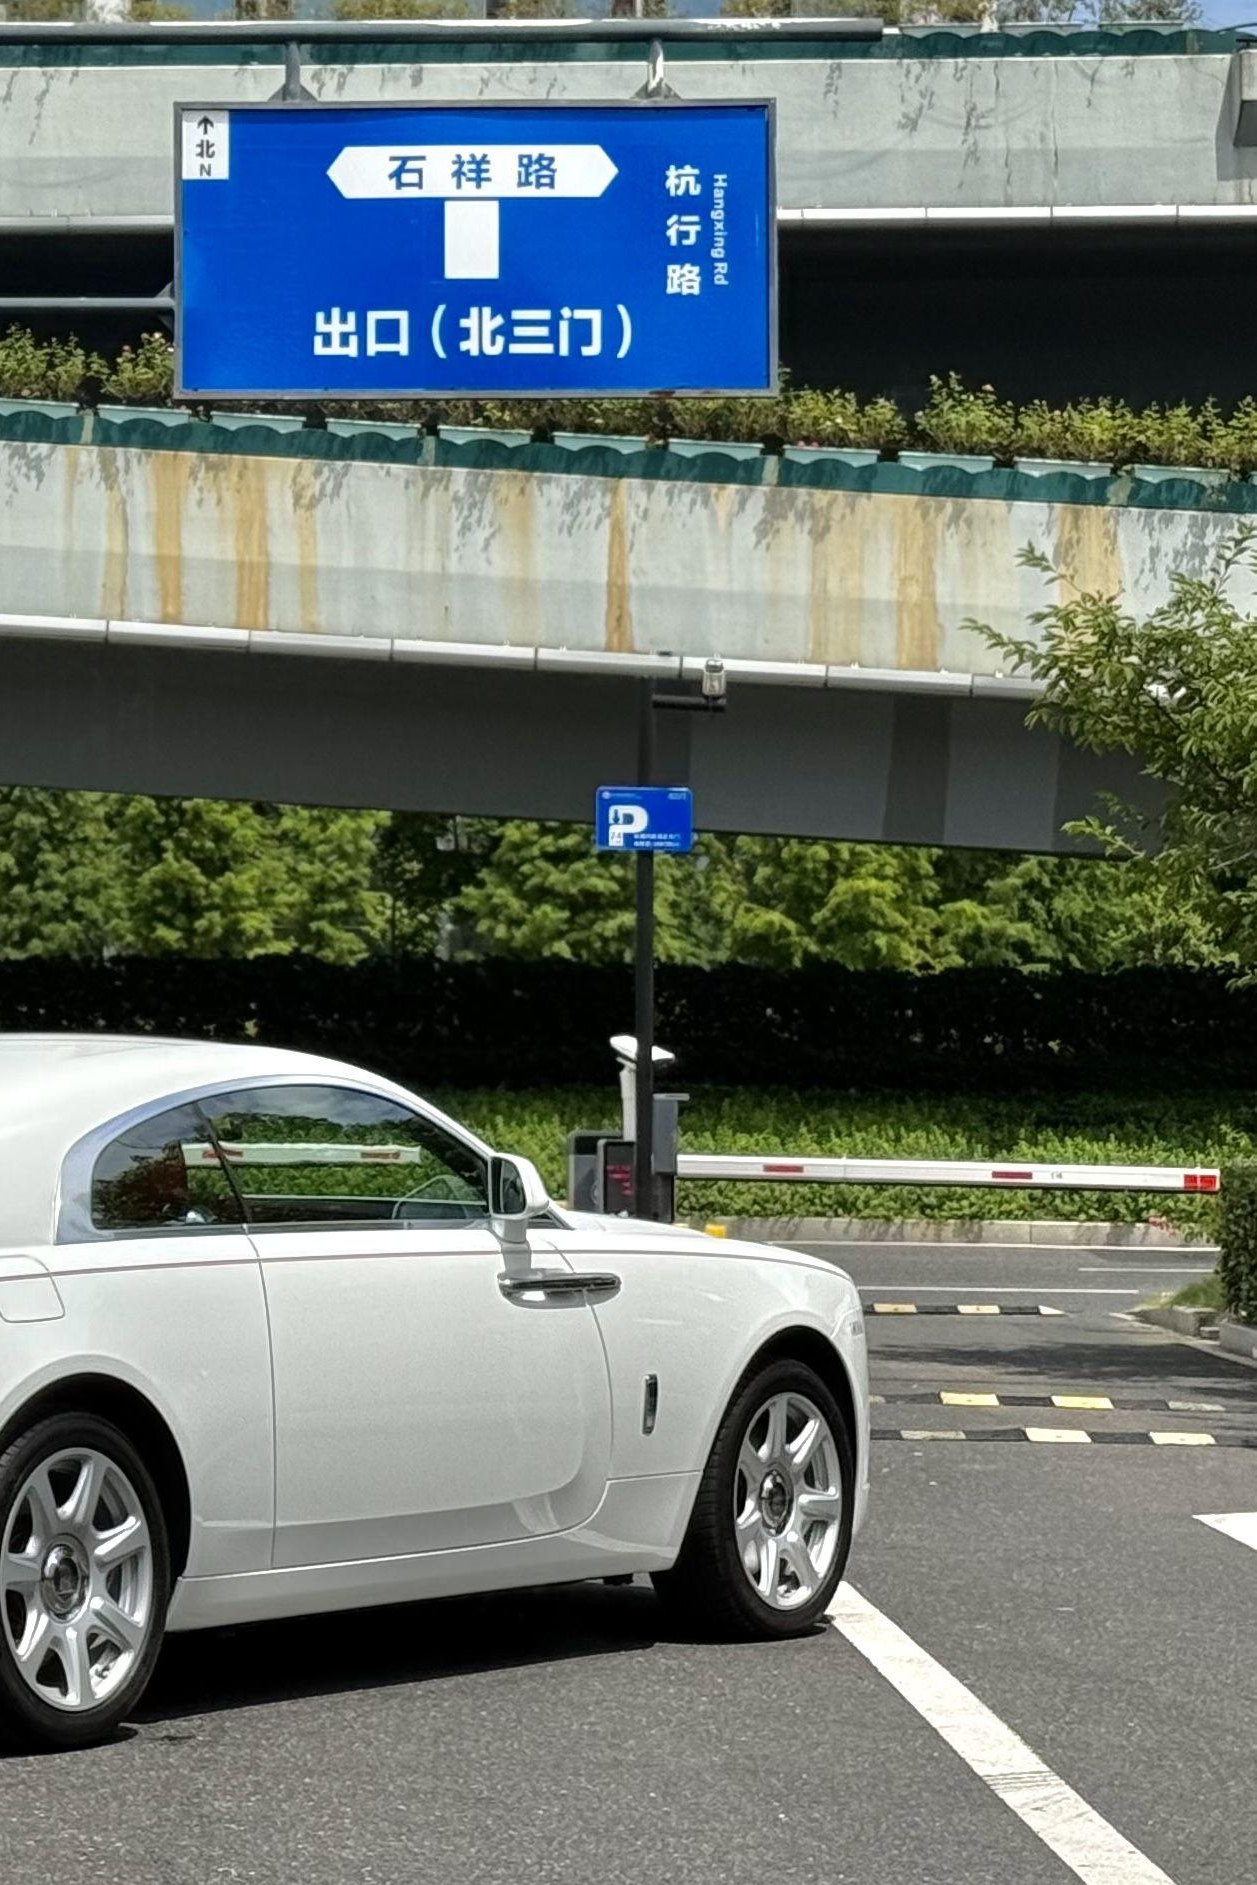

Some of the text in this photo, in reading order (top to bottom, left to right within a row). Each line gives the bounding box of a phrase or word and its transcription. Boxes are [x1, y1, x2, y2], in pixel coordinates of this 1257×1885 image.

[196, 139, 215, 158] 北
[200, 163, 211, 176] N
[388, 153, 557, 190] 石祥路
[665, 165, 701, 295] 杭行路
[710, 174, 729, 285] Hangxing Rd
[608, 805, 648, 847] P
